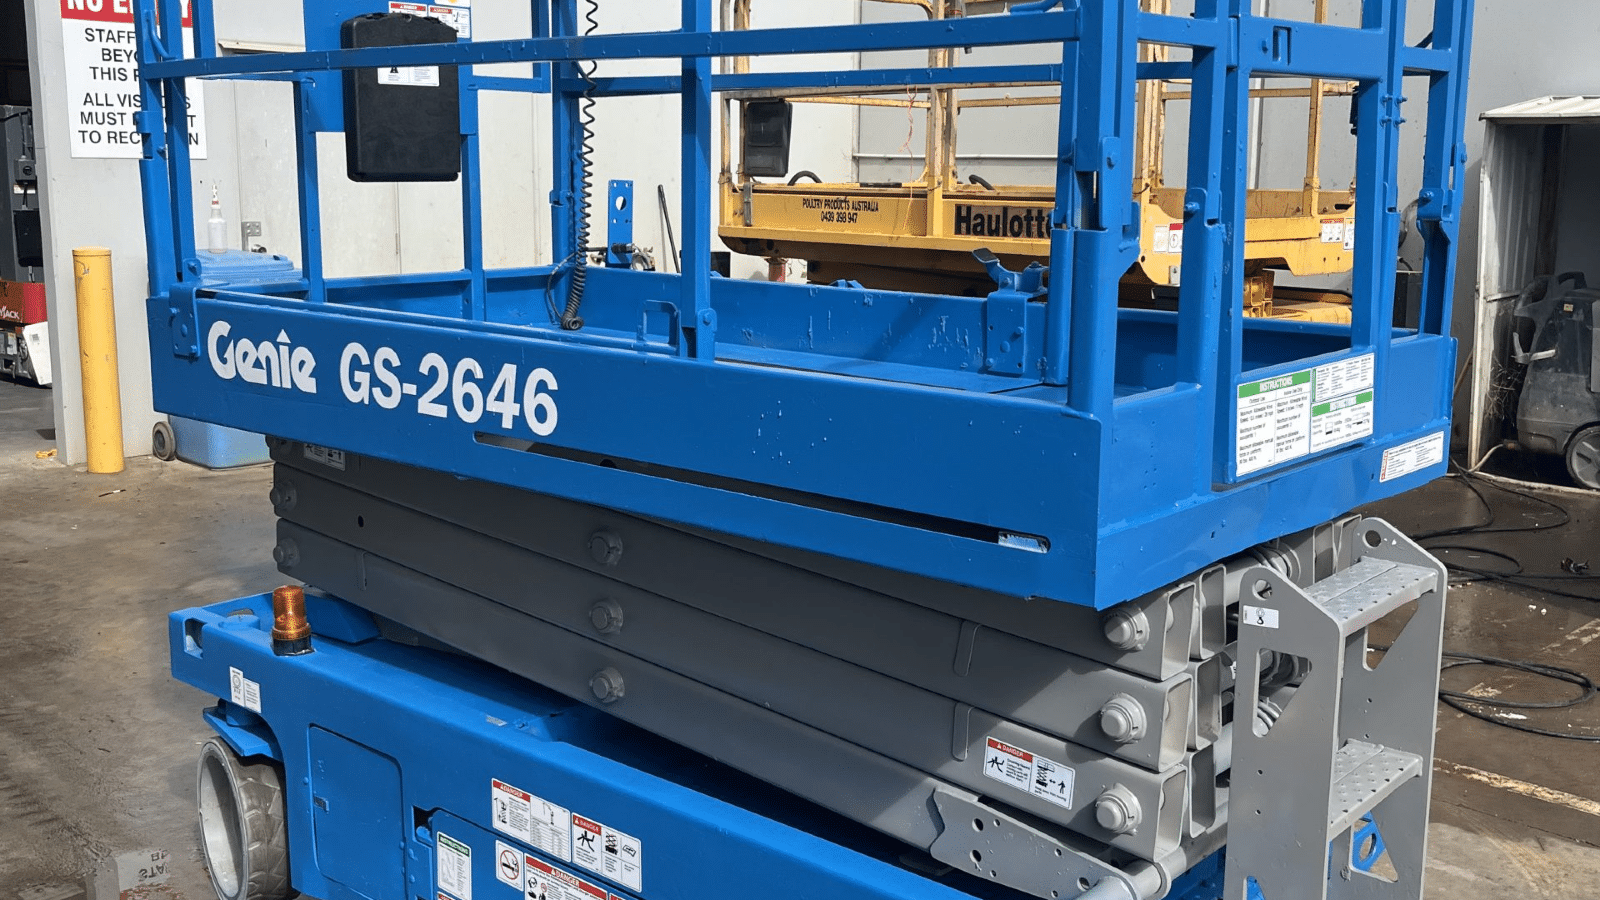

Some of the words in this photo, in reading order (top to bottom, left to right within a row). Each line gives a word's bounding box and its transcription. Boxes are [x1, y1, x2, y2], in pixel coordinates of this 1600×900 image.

[85, 28, 136, 44] STAFF
[102, 48, 138, 63] BEY
[89, 66, 128, 81] THIS
[83, 92, 114, 107] ALL
[80, 111, 127, 125] MUST
[78, 130, 102, 144] TO
[803, 198, 823, 209] POULTRY
[824, 198, 850, 210] PRODUCTS
[852, 200, 879, 212] AUSTRALIA
[207, 320, 317, 394] Genie
[340, 342, 559, 437] GS-2646
[1259, 376, 1293, 392] INSTRUCTIONS
